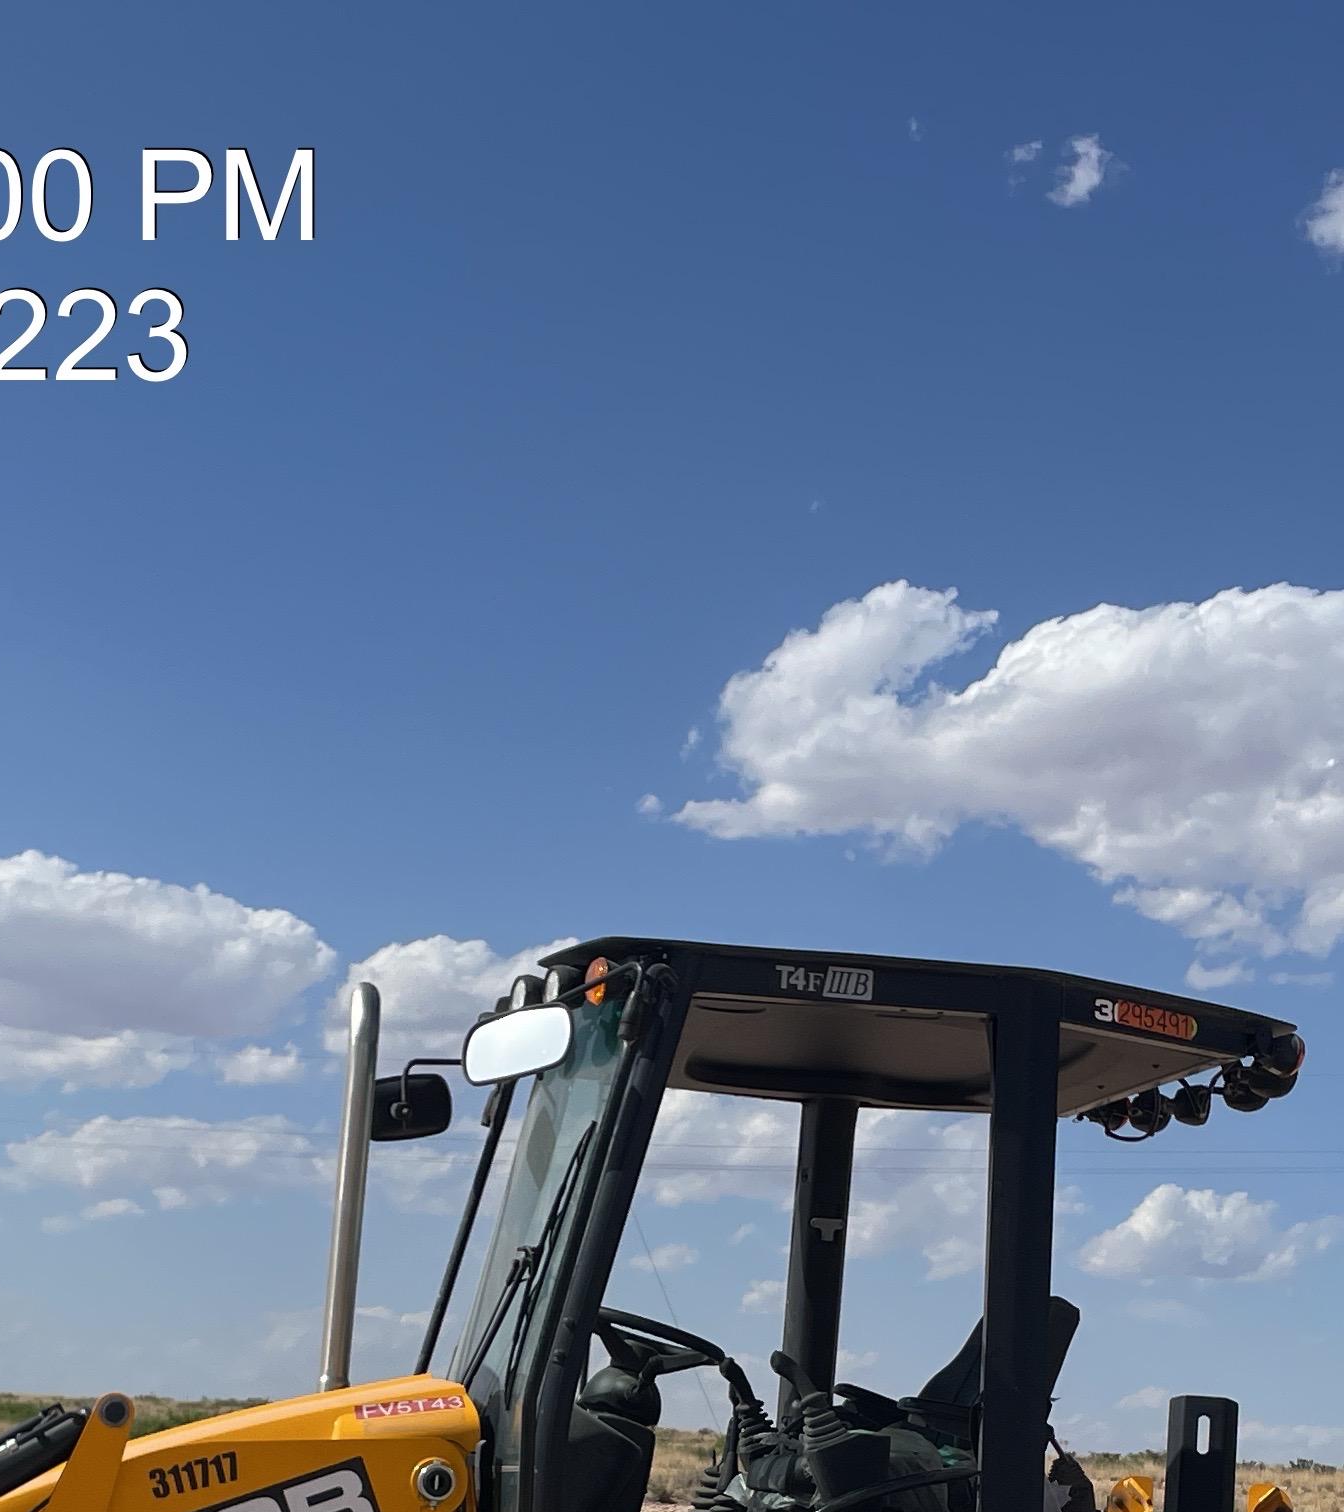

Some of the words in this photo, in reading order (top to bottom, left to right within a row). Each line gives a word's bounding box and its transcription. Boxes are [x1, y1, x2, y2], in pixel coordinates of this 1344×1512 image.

[1117, 1001, 1191, 1038] 295491
[361, 1395, 464, 1419] FV5T43
[149, 1450, 238, 1498] 311717
